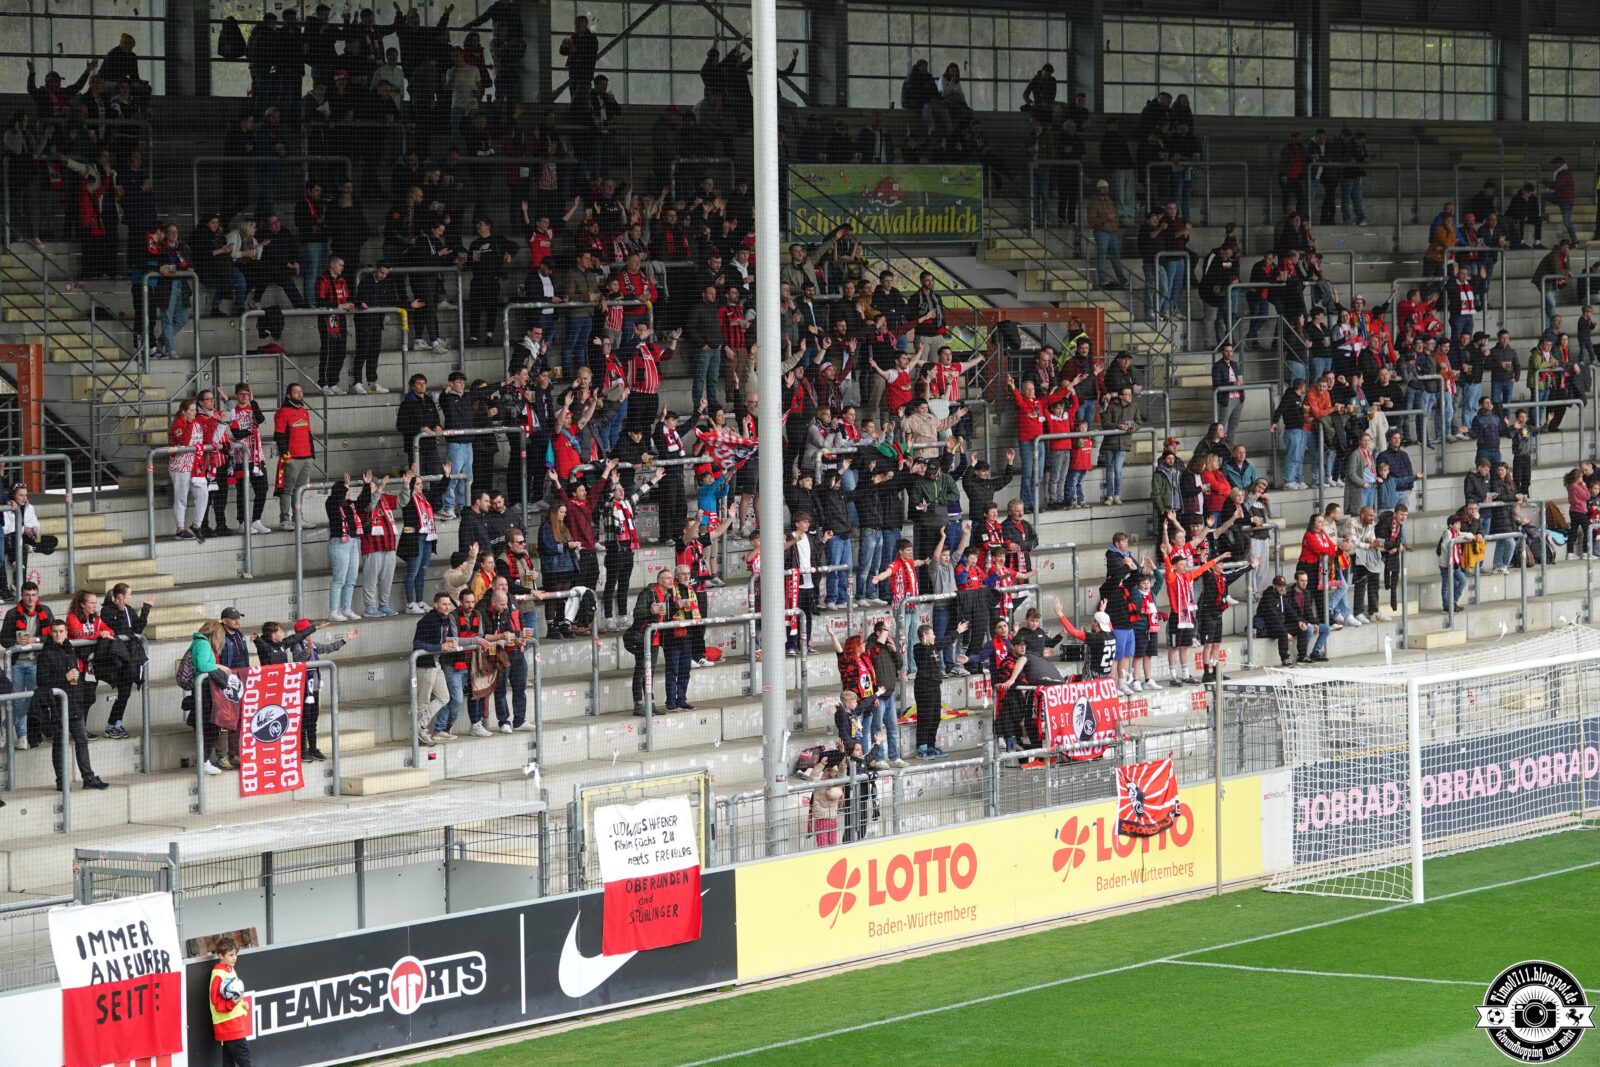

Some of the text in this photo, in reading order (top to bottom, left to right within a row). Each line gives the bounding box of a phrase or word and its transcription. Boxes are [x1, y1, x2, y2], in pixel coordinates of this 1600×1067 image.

[794, 206, 977, 236] Schwarzwaldmilch
[1047, 679, 1118, 707] SPORTCLUB
[1506, 746, 1599, 794] JOBRAD
[1296, 781, 1400, 833] JOBRAD
[868, 842, 978, 907] LOTTO
[1096, 861, 1194, 892] Baden-Württemberg
[868, 904, 977, 938] Baden-Württemberg
[76, 920, 154, 960] IMMER
